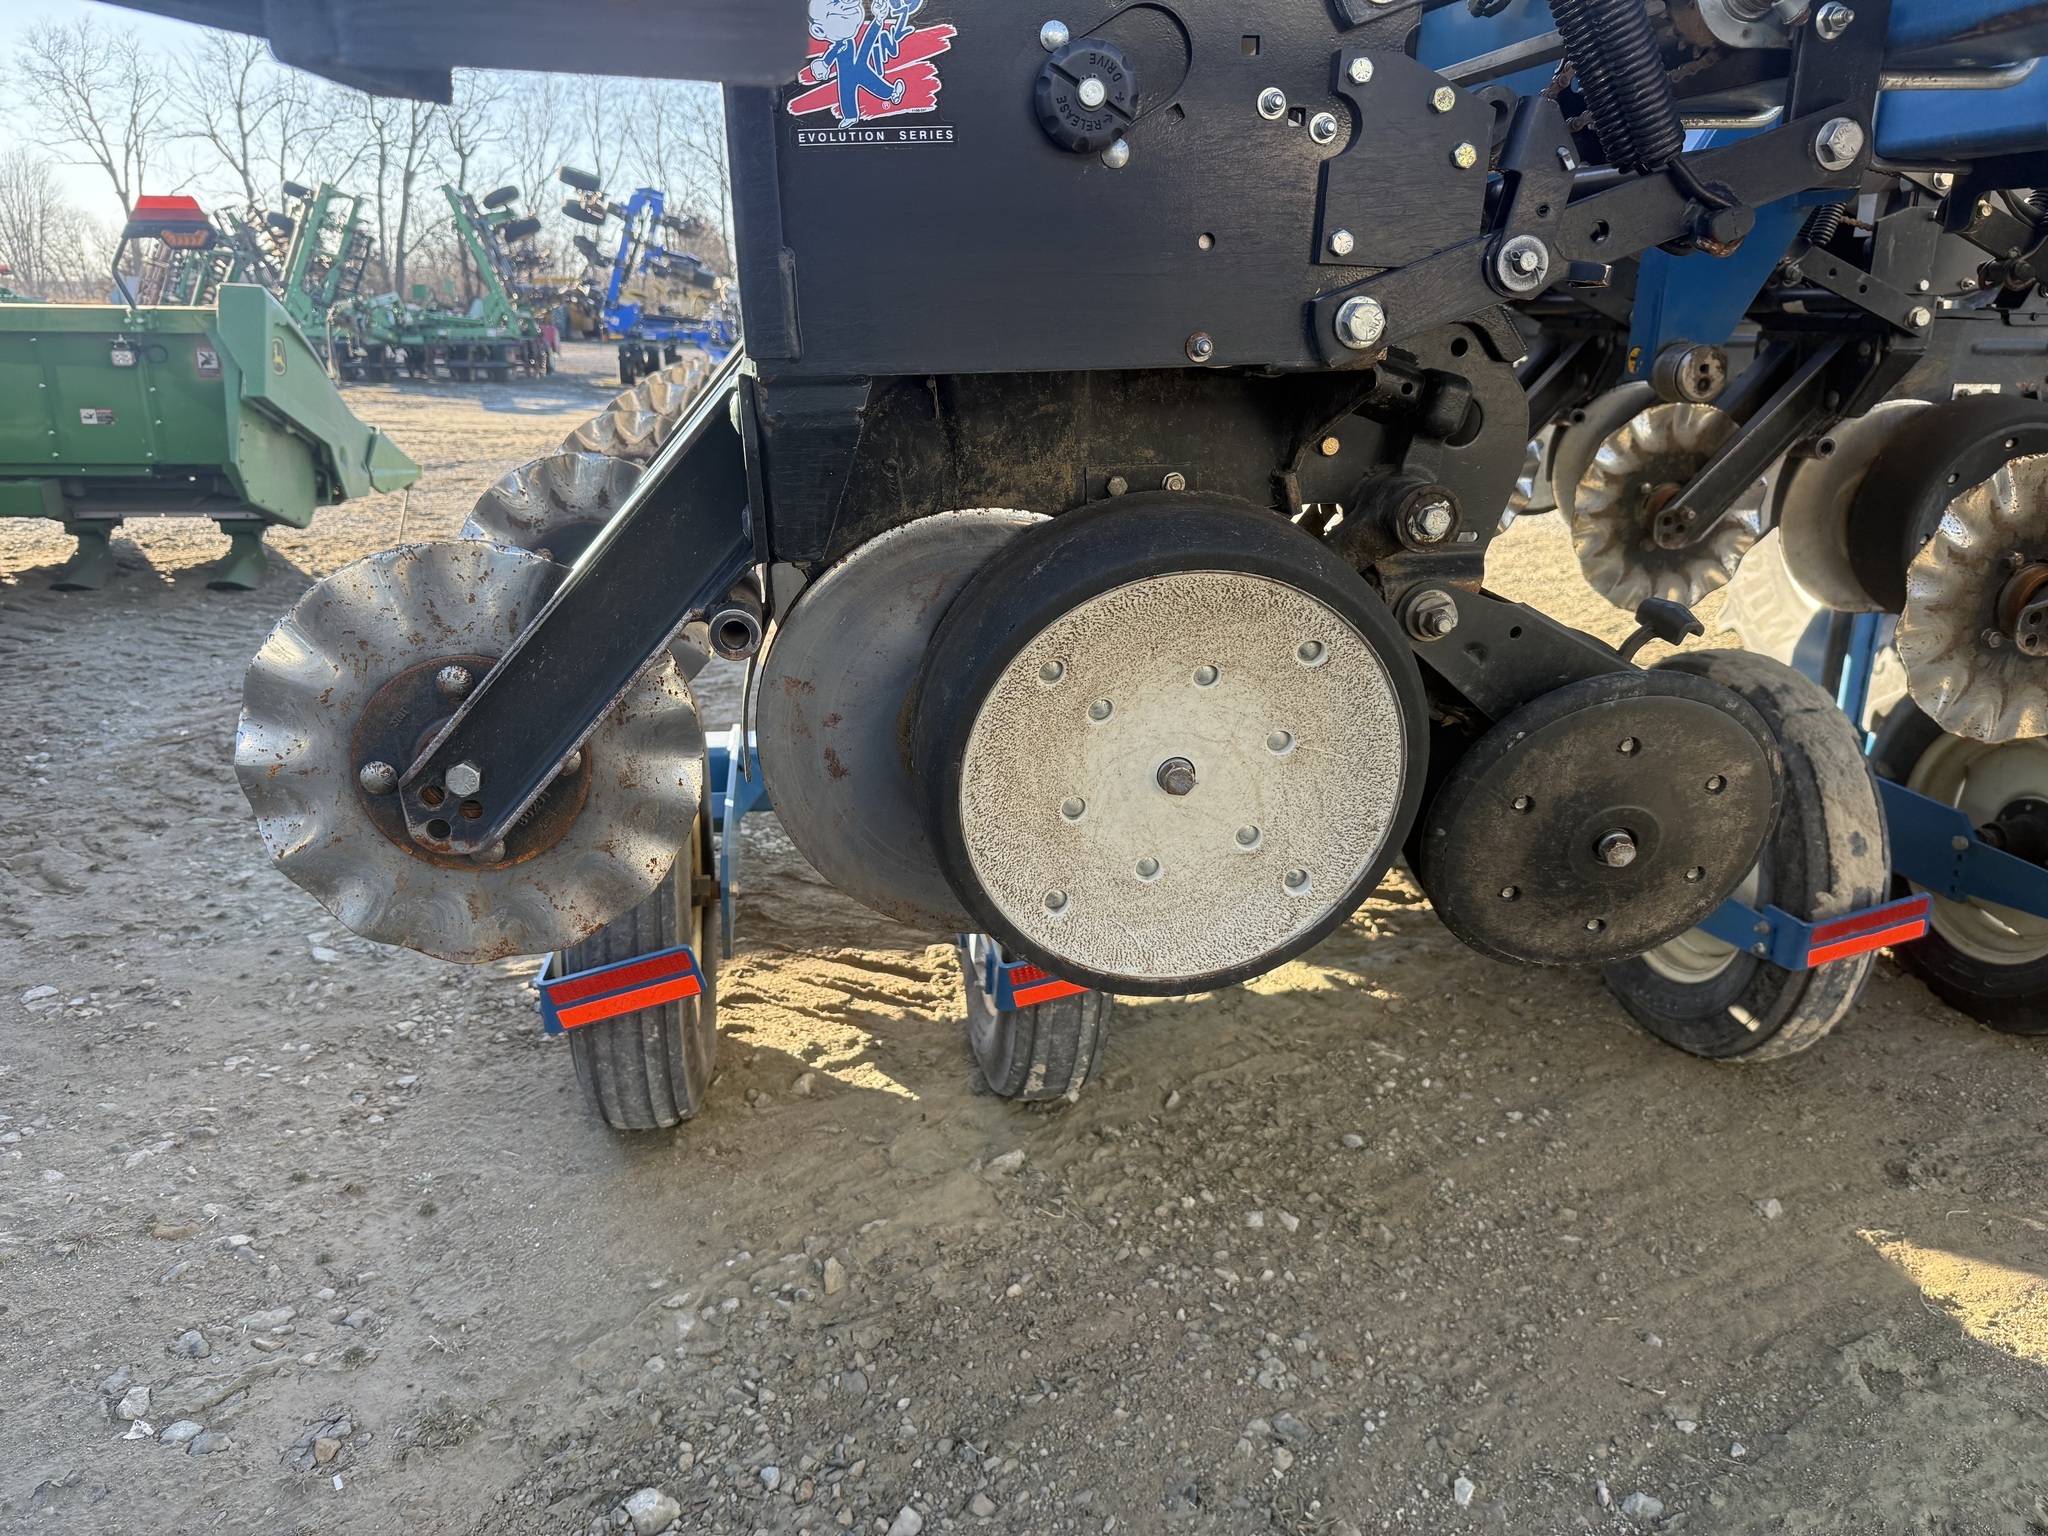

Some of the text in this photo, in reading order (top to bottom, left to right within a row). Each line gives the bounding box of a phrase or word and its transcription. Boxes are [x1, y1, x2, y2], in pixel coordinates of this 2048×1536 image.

[822, 0, 923, 129] KINZ
[1089, 53, 1122, 82] DRIVE
[1056, 95, 1102, 131] RELEASE
[798, 130, 953, 143] EVOLUTION SERIES
